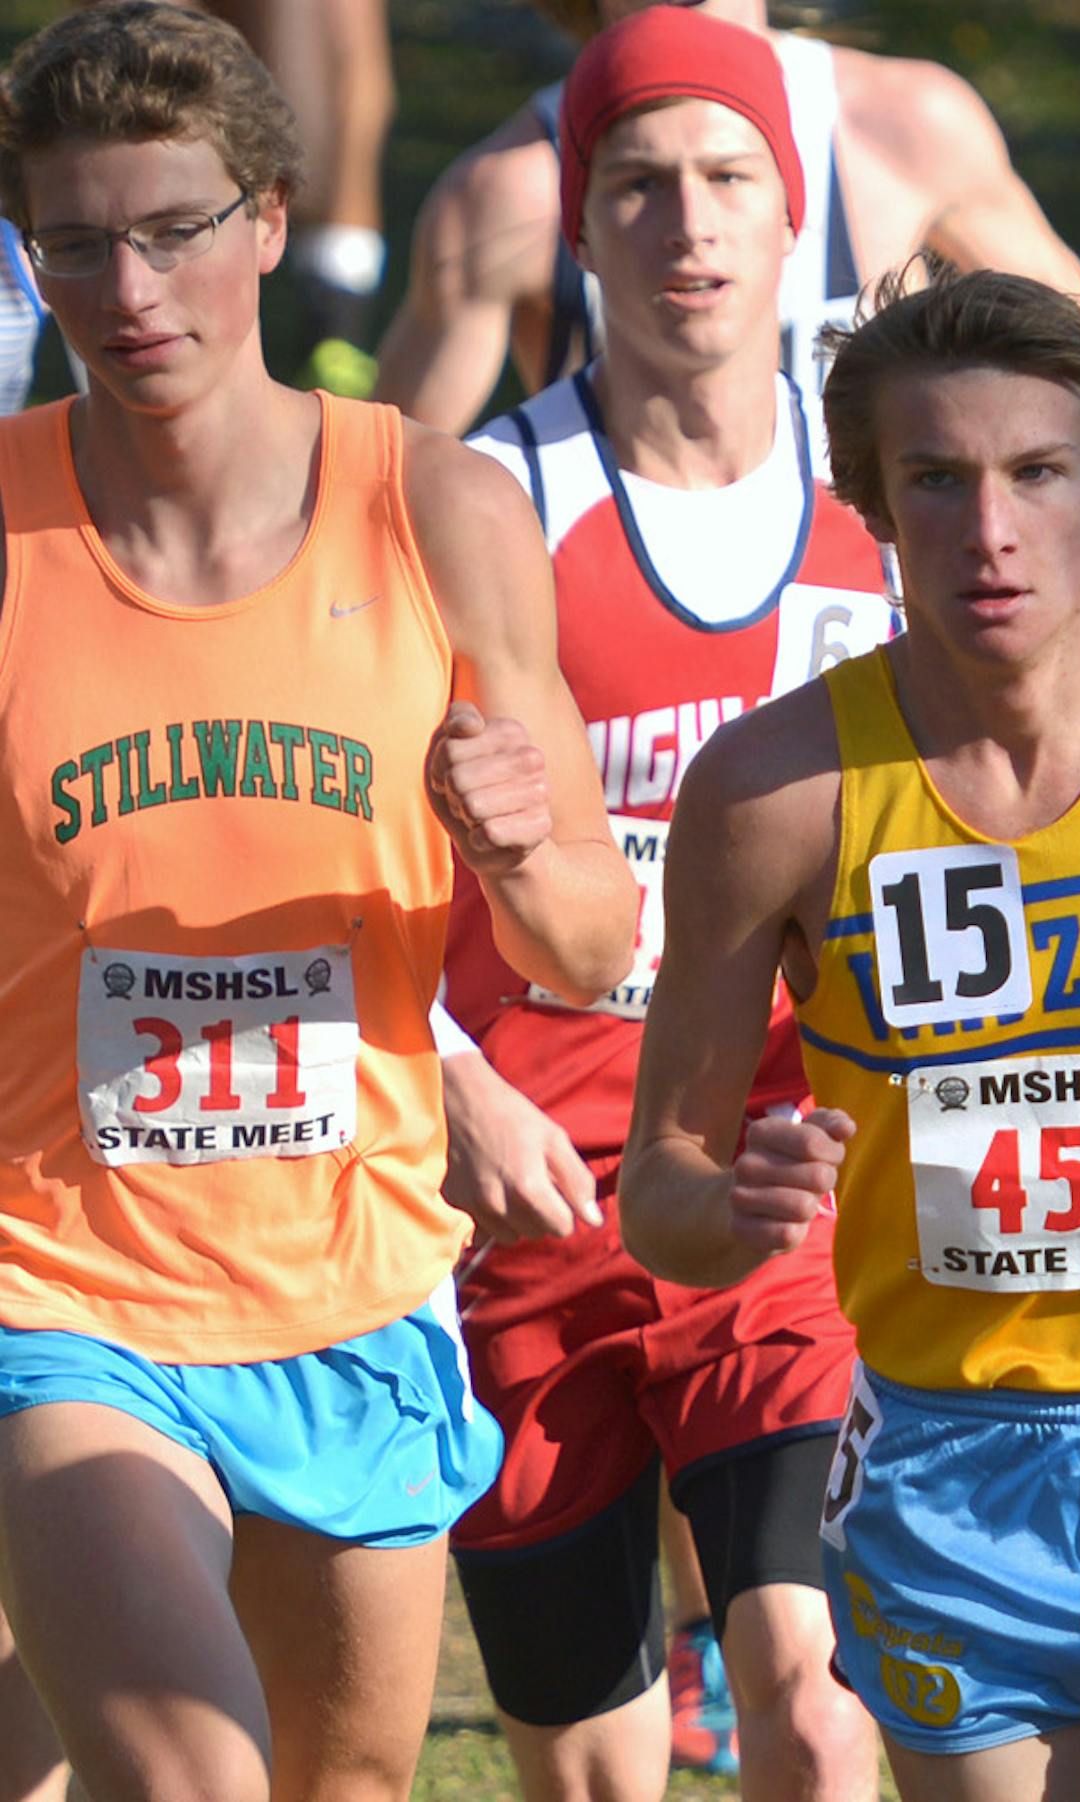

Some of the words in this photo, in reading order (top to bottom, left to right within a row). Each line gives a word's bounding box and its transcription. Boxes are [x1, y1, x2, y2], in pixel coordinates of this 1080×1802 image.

[50, 719, 374, 844] STILLWATER
[881, 863, 1013, 1007] 15
[143, 967, 299, 1001] MSHSL
[132, 1015, 307, 1113] 311
[97, 1125, 217, 1151] STATE
[231, 1113, 335, 1149] MEET
[943, 1245, 1068, 1276] STATE
